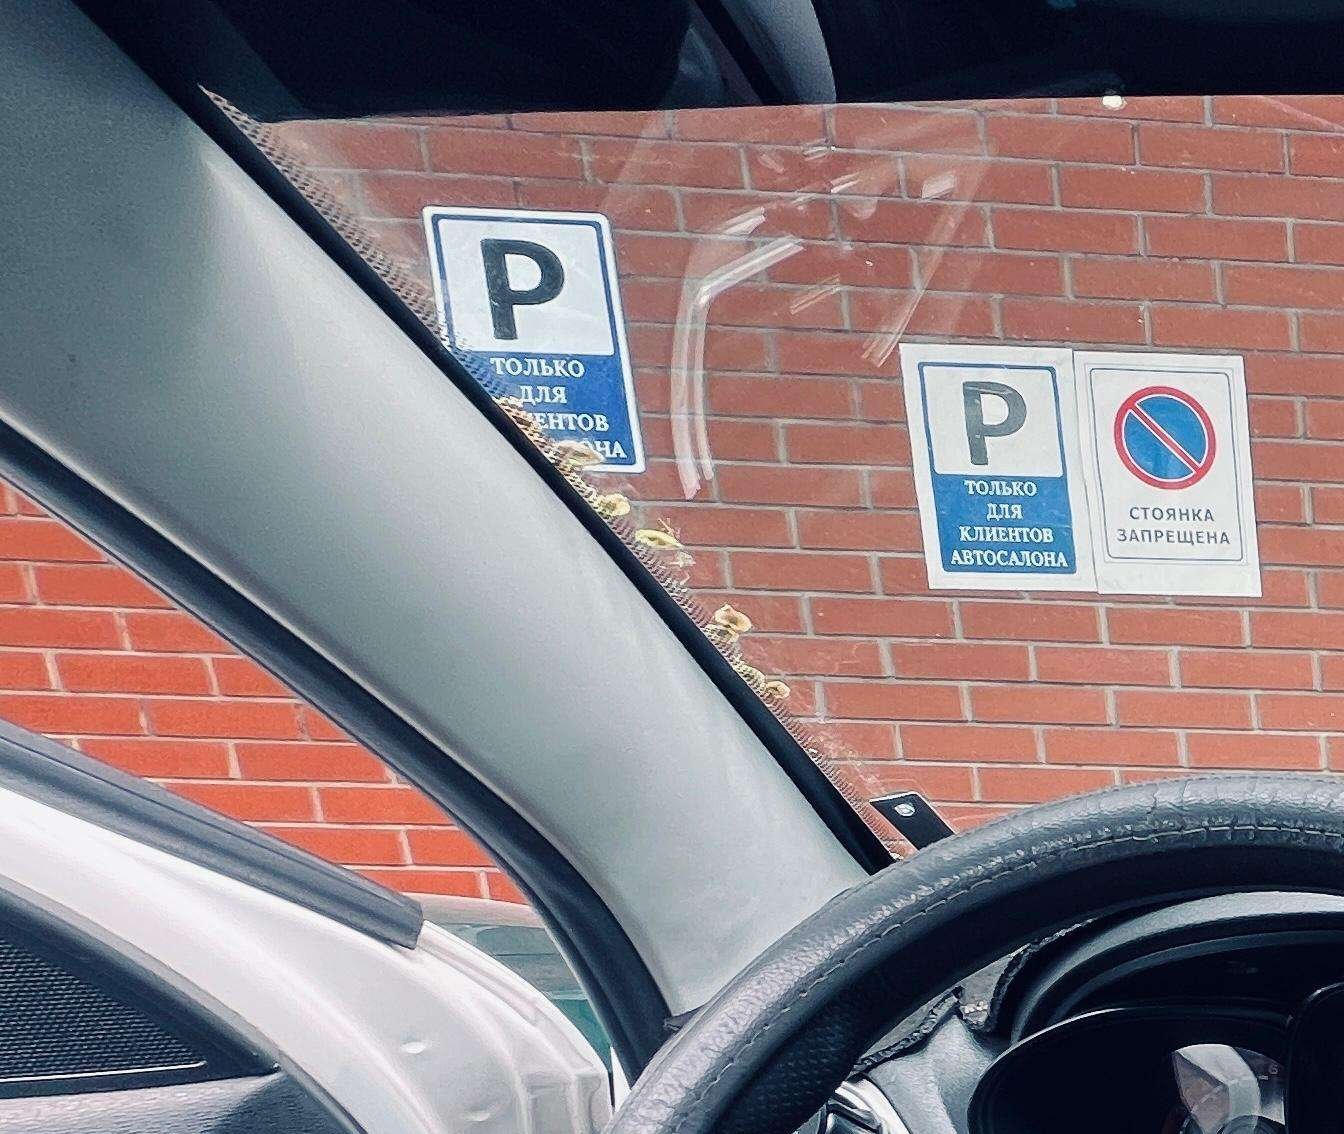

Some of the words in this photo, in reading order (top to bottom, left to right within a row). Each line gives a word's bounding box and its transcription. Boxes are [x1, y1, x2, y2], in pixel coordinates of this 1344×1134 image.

[480, 238, 565, 339] P
[490, 357, 585, 378] ТОЛЬКО
[520, 386, 567, 404] ДЛЯ
[533, 412, 609, 432] ЕНТОВ
[963, 381, 1027, 465] P
[964, 480, 1037, 496] ТОЛЬКО
[987, 503, 1023, 520] ДЛЯ
[1129, 507, 1215, 522] СТОЯНКА
[959, 526, 1054, 543] КЛИЕНТОВ
[1117, 529, 1230, 545] ЗАПРЕЩЕНА
[950, 550, 1069, 568] АВТОСАЛОНА
